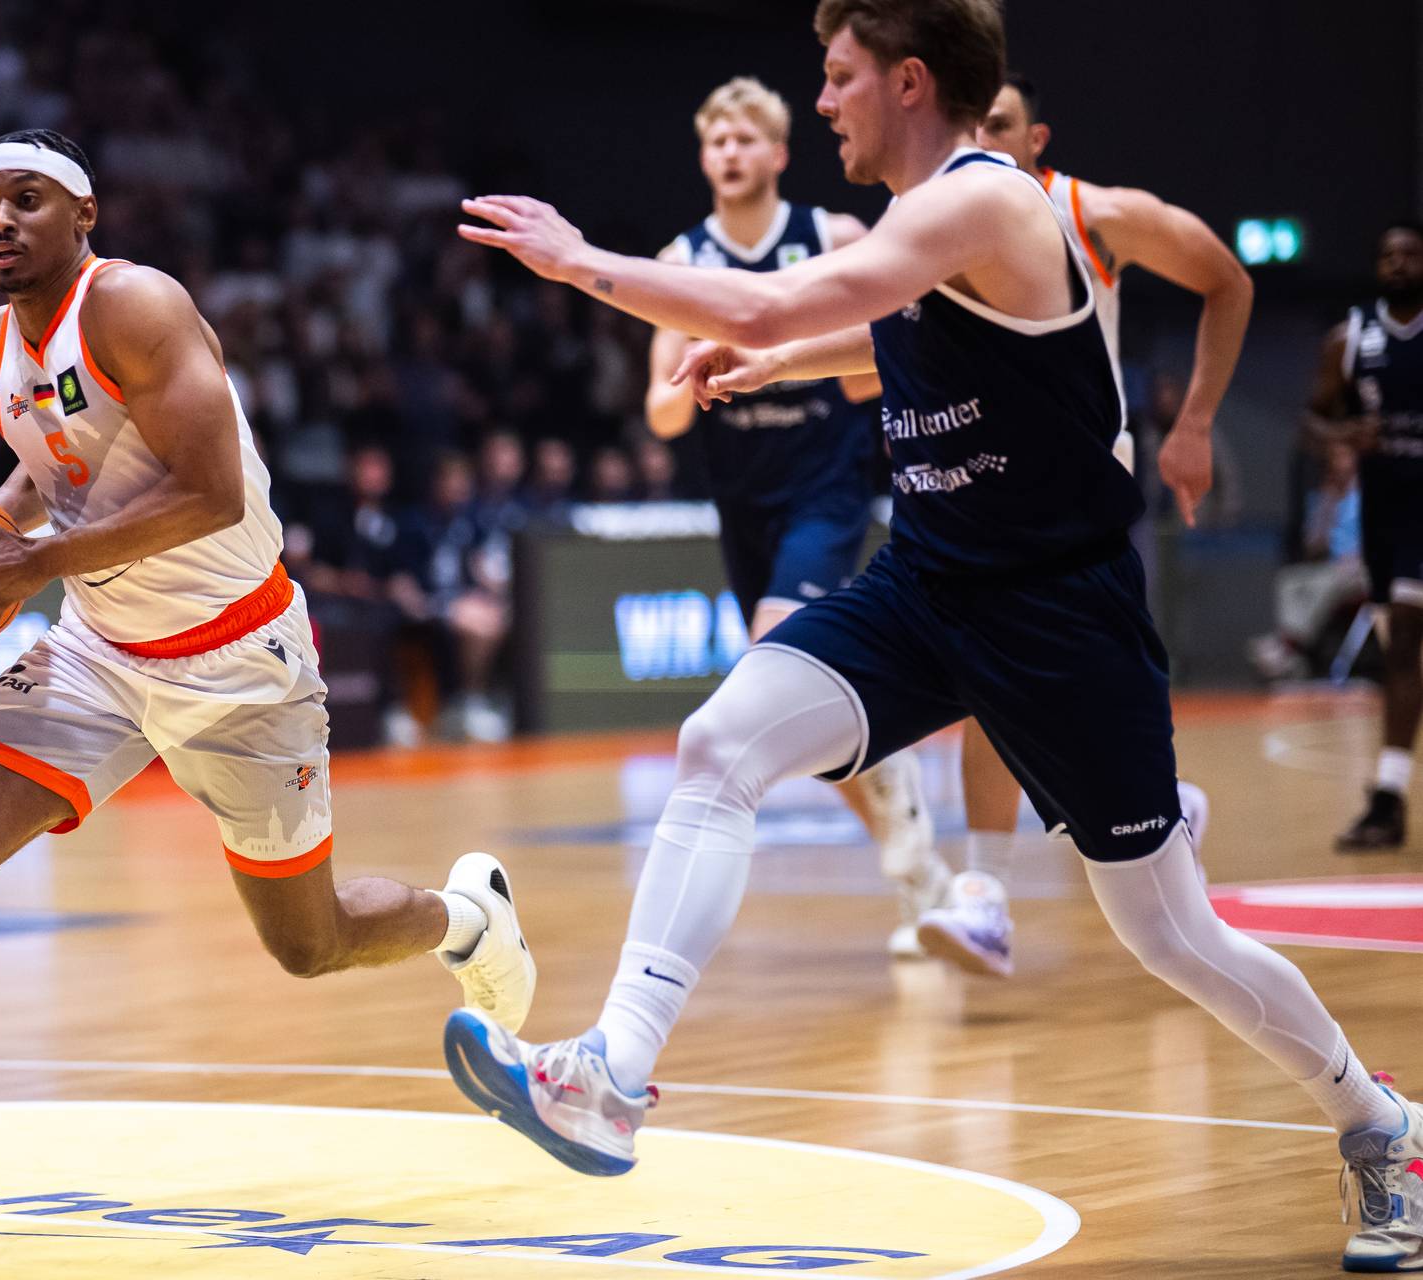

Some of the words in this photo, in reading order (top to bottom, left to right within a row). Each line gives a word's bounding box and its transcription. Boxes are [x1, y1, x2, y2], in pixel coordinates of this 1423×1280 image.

[45, 431, 90, 487] 5
[1111, 819, 1158, 836] CRAFT
[419, 1232, 929, 1271] AG
